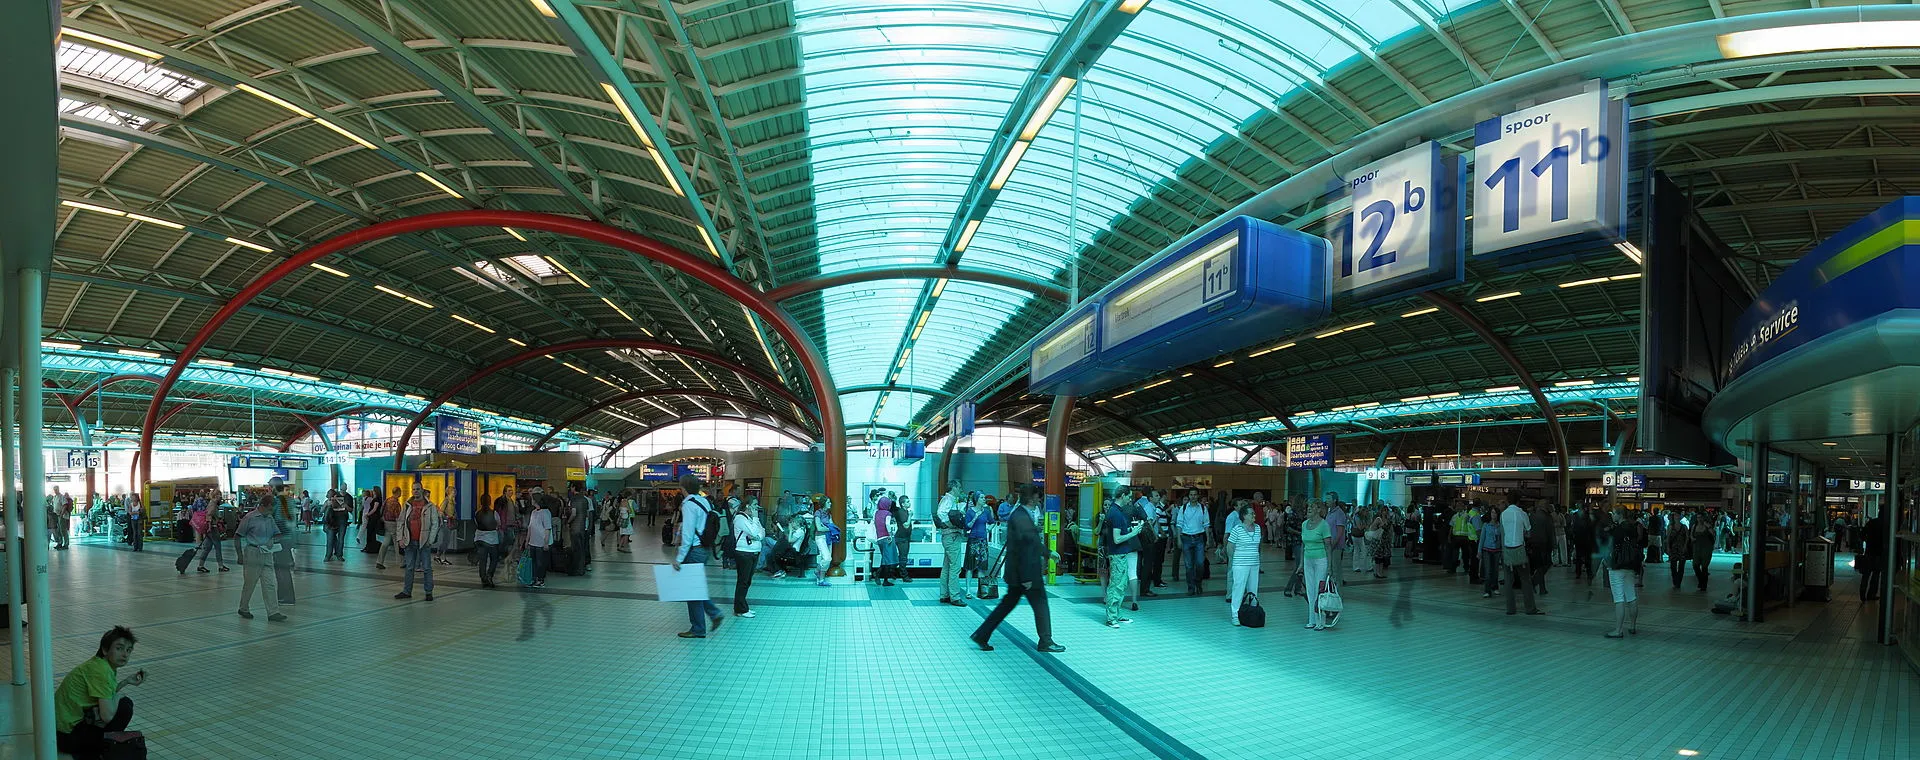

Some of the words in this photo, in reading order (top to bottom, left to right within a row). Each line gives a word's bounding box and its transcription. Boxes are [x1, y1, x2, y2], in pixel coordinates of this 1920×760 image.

[1505, 112, 1551, 134] spoor
[1351, 169, 1380, 190] poor
[1759, 306, 1798, 345] Service
